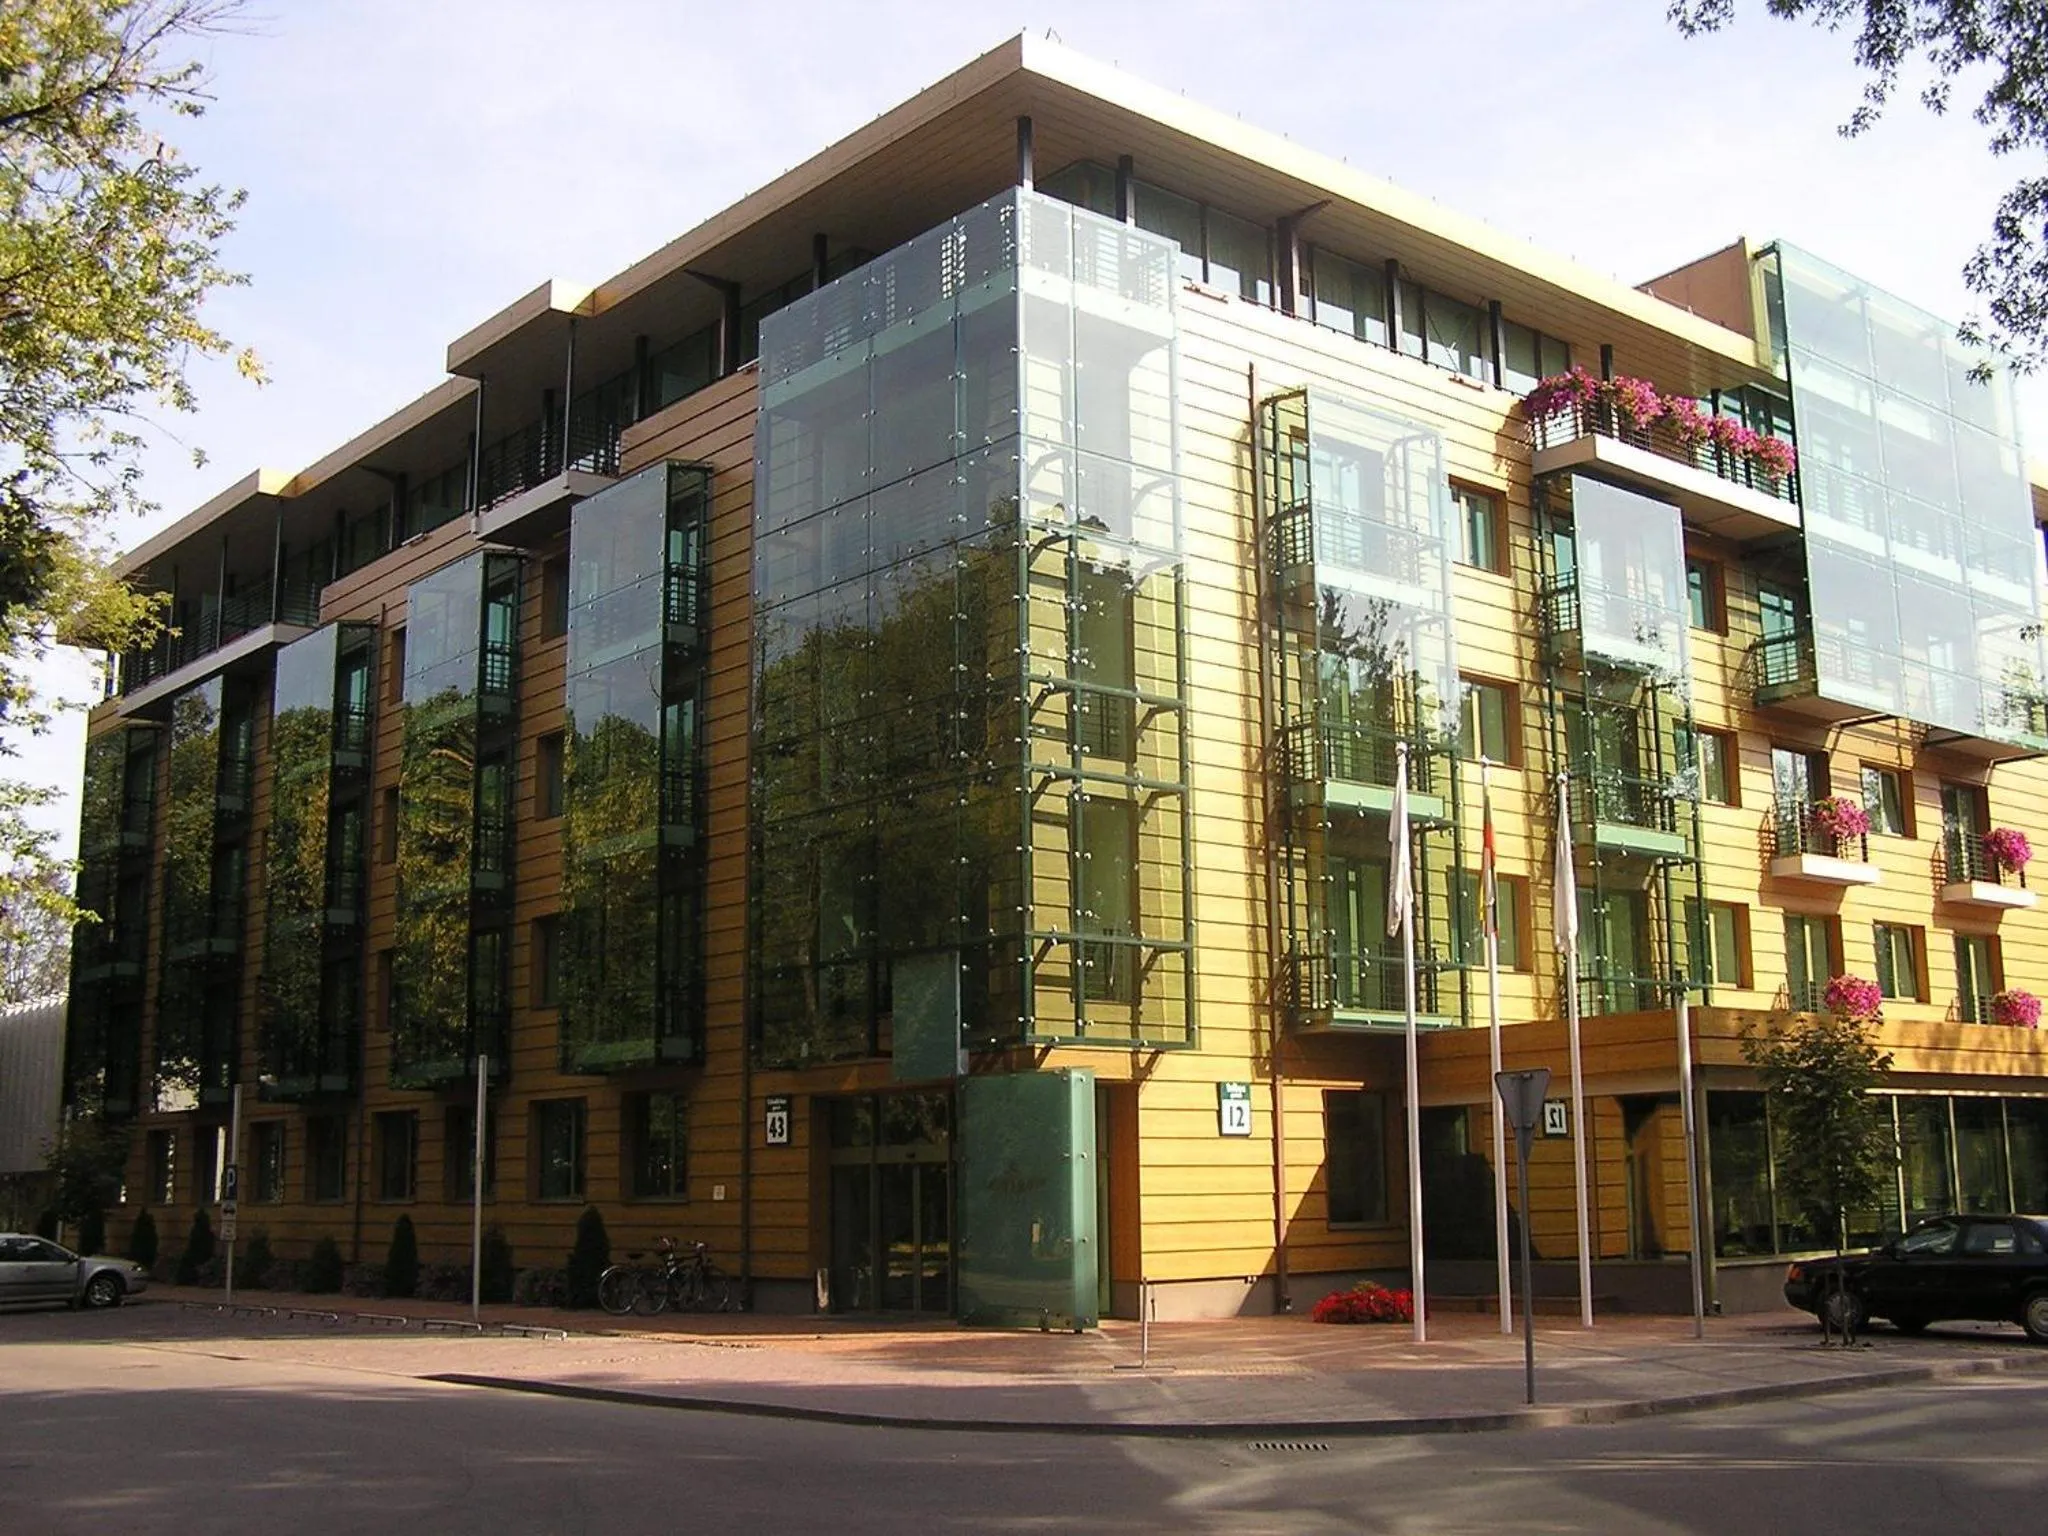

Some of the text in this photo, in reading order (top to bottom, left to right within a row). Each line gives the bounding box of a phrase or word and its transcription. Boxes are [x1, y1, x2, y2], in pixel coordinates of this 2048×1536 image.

[768, 1116, 785, 1138] 43
[1229, 1105, 1245, 1127] 12
[226, 1167, 236, 1197] P
